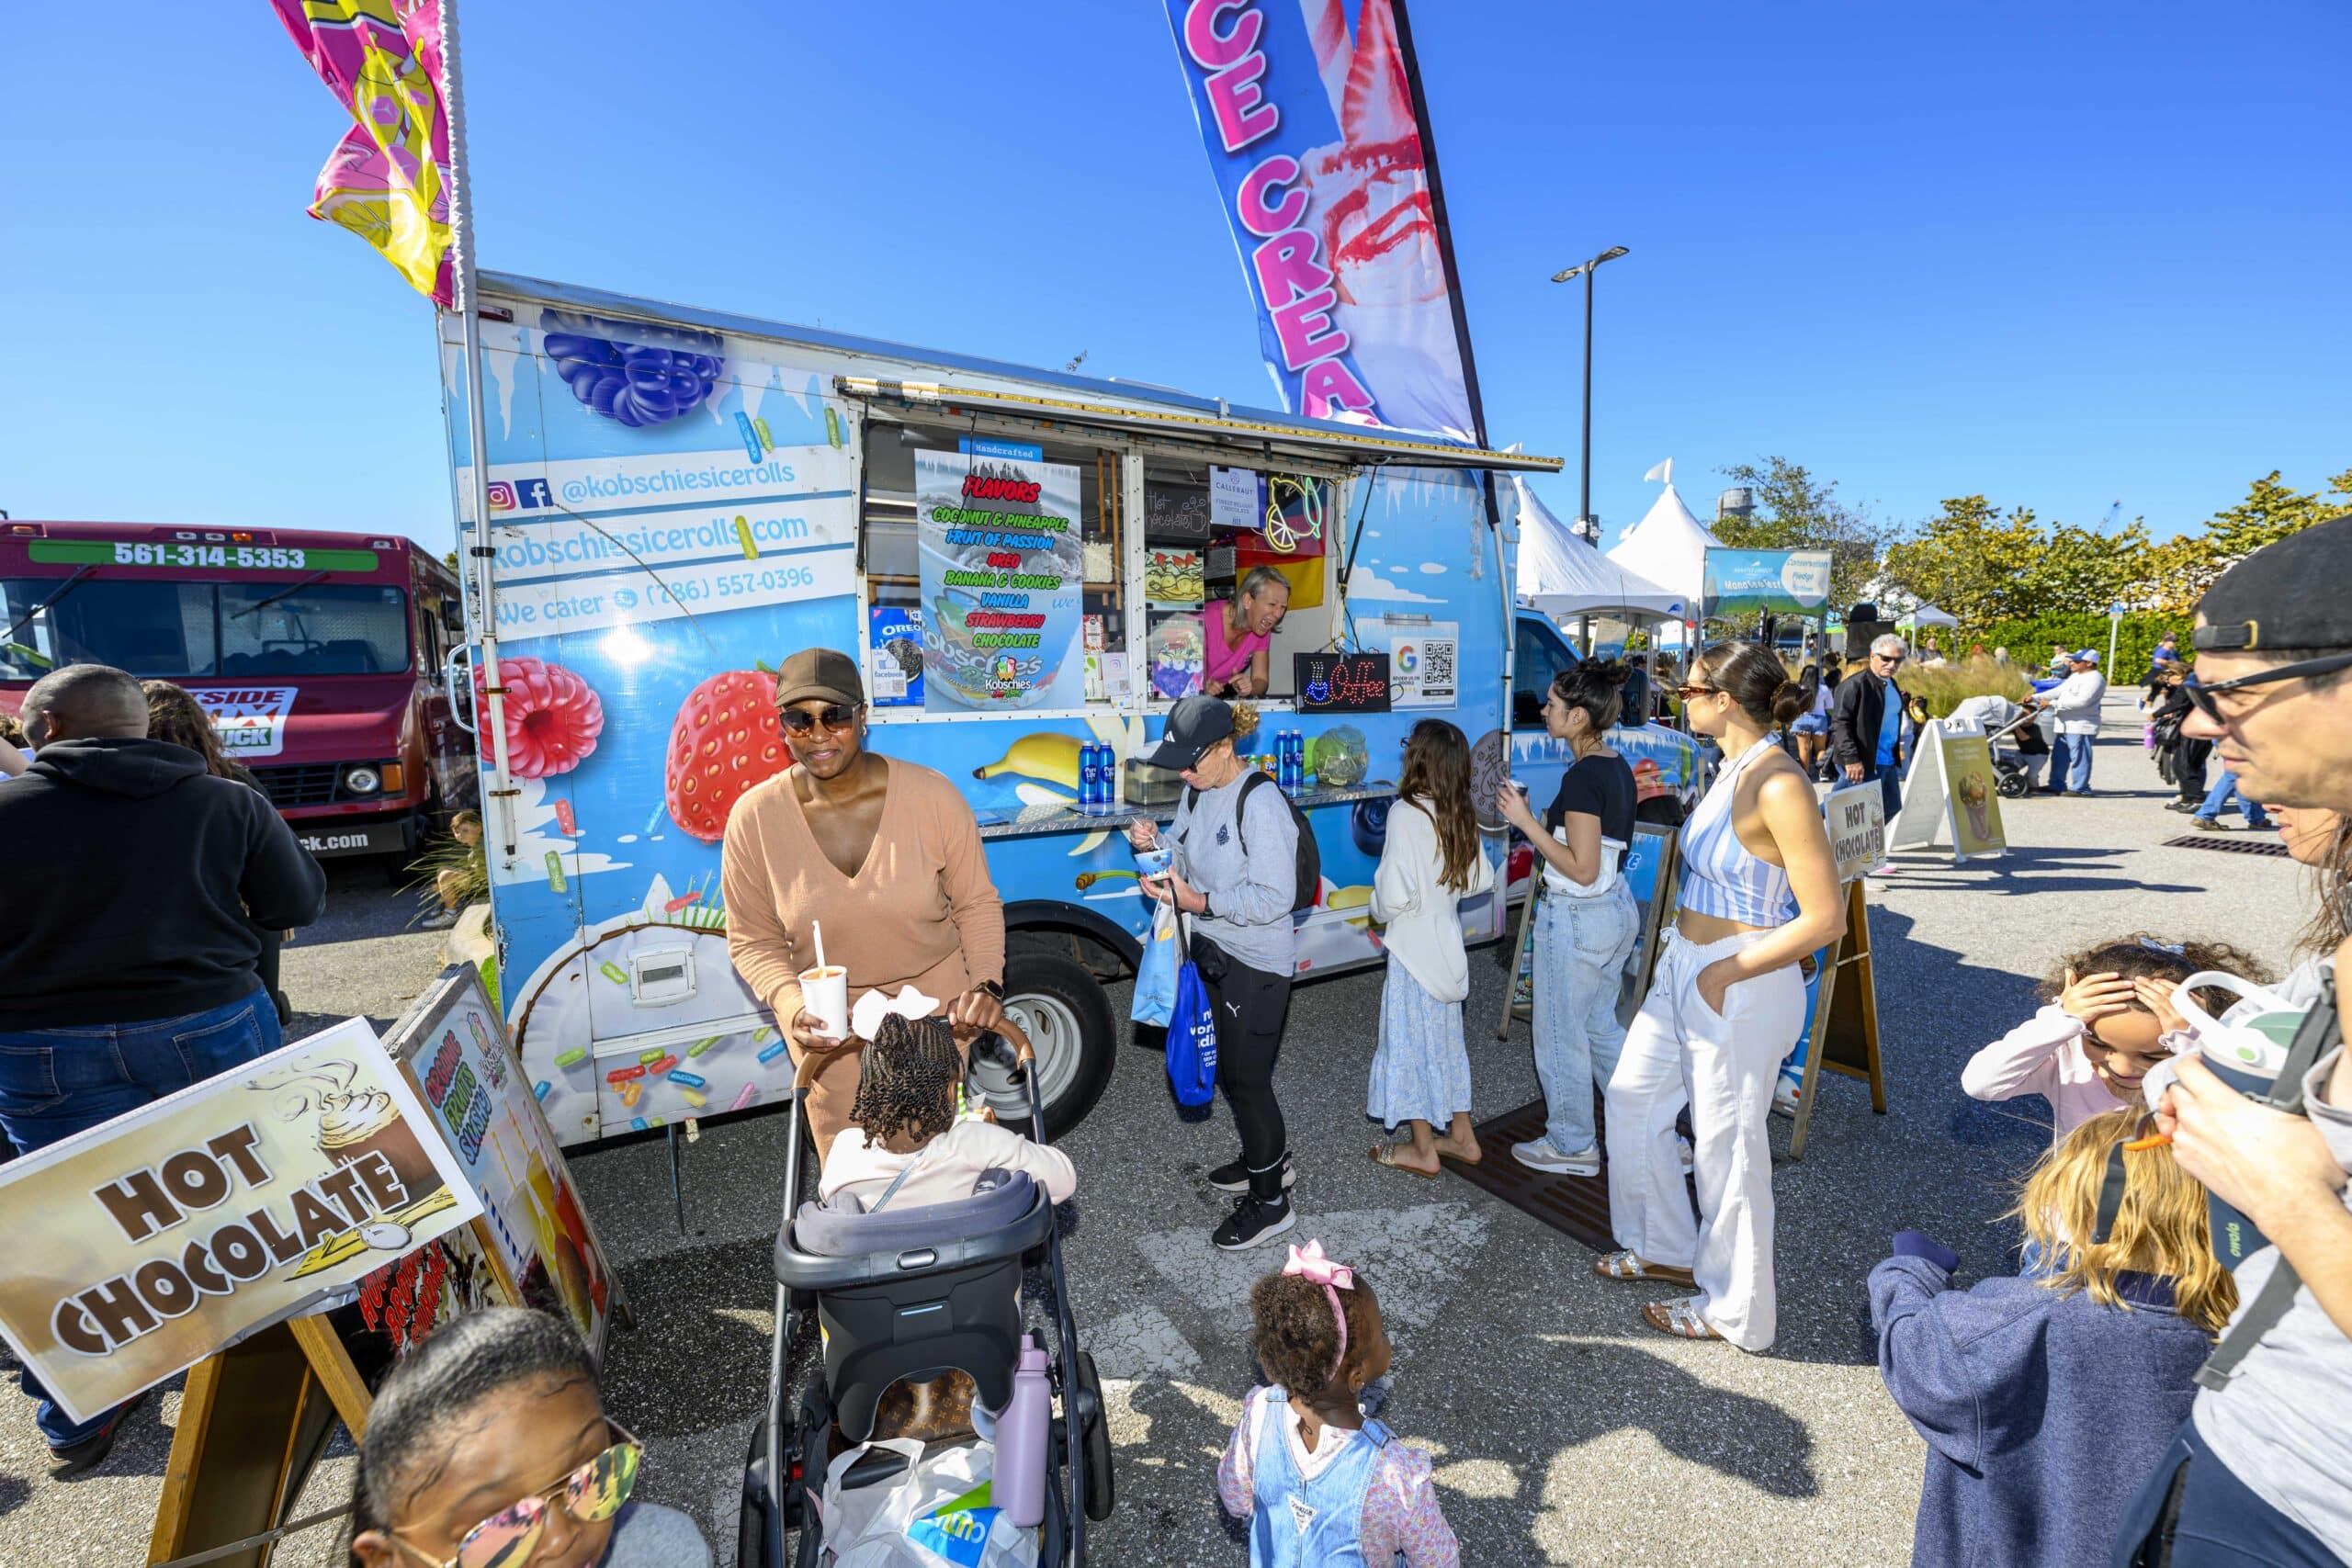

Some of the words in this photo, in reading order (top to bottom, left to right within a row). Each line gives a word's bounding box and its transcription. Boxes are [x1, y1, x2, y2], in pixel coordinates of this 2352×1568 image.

[1184, 0, 1279, 152] CE
[1238, 154, 1378, 426] CREA
[975, 444, 1034, 458] Handcrafted
[562, 462, 795, 503] @kobschiesicerolls
[962, 476, 1041, 503] FLAVORS
[1216, 481, 1253, 495] CALLEBAUT
[933, 507, 992, 525] COCONUT
[992, 511, 1002, 526] &
[1004, 513, 1069, 532] PINEAPPLE
[492, 516, 808, 570] kobschiesicerollscom
[946, 529, 983, 546] FRUIT
[983, 532, 1001, 547] OF
[1001, 534, 1056, 551] PASSION
[114, 543, 305, 569] 561-314-5353
[987, 552, 1021, 569] OREO
[944, 570, 997, 589] BANANA
[997, 573, 1009, 588] &
[1011, 573, 1062, 590] COOKIES
[496, 601, 537, 626] We
[544, 594, 604, 619] cater
[646, 578, 710, 607] (786)
[718, 566, 814, 596] 557-0396
[981, 592, 1029, 609] VANILLA
[882, 625, 922, 636] OREO
[966, 613, 1046, 628] STRAWBERRY
[972, 633, 1040, 649] CHOCOLATE
[1329, 662, 1385, 705] Coffee
[216, 728, 270, 746] UCK
[1844, 802, 1866, 829] HOT
[299, 833, 368, 852] ck.com
[1834, 829, 1880, 863] CHOCOLATE
[424, 1029, 463, 1109] ORGANIC
[443, 1061, 477, 1136] FRUITS
[459, 1084, 492, 1166] SLUSHY
[92, 1120, 274, 1245] HOT
[51, 1149, 410, 1357] CHOCOLATE
[2225, 1222, 2242, 1258] owala
